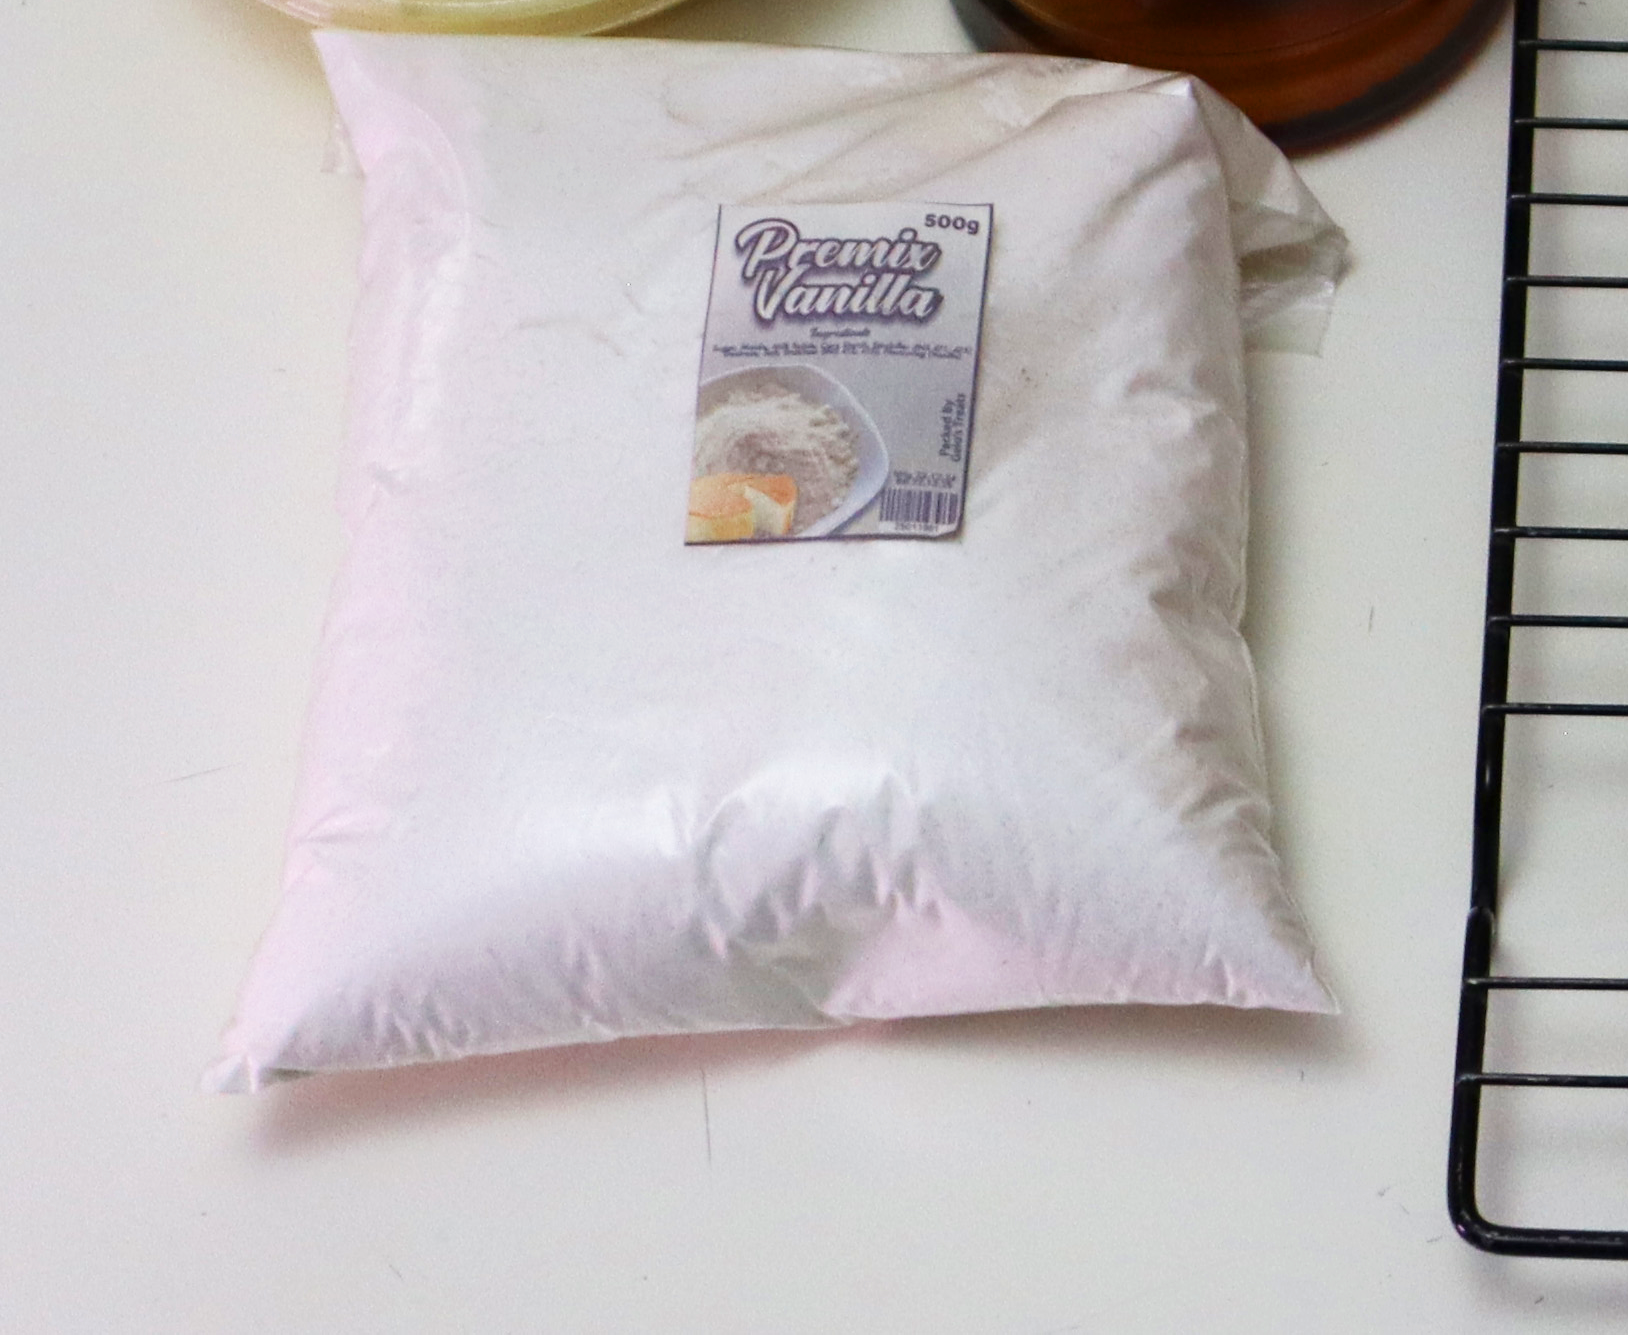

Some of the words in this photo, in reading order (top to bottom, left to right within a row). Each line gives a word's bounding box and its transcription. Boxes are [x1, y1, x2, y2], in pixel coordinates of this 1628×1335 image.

[735, 217, 943, 282] Premix
[923, 213, 980, 236] 500g
[752, 265, 945, 328] Vanilla
